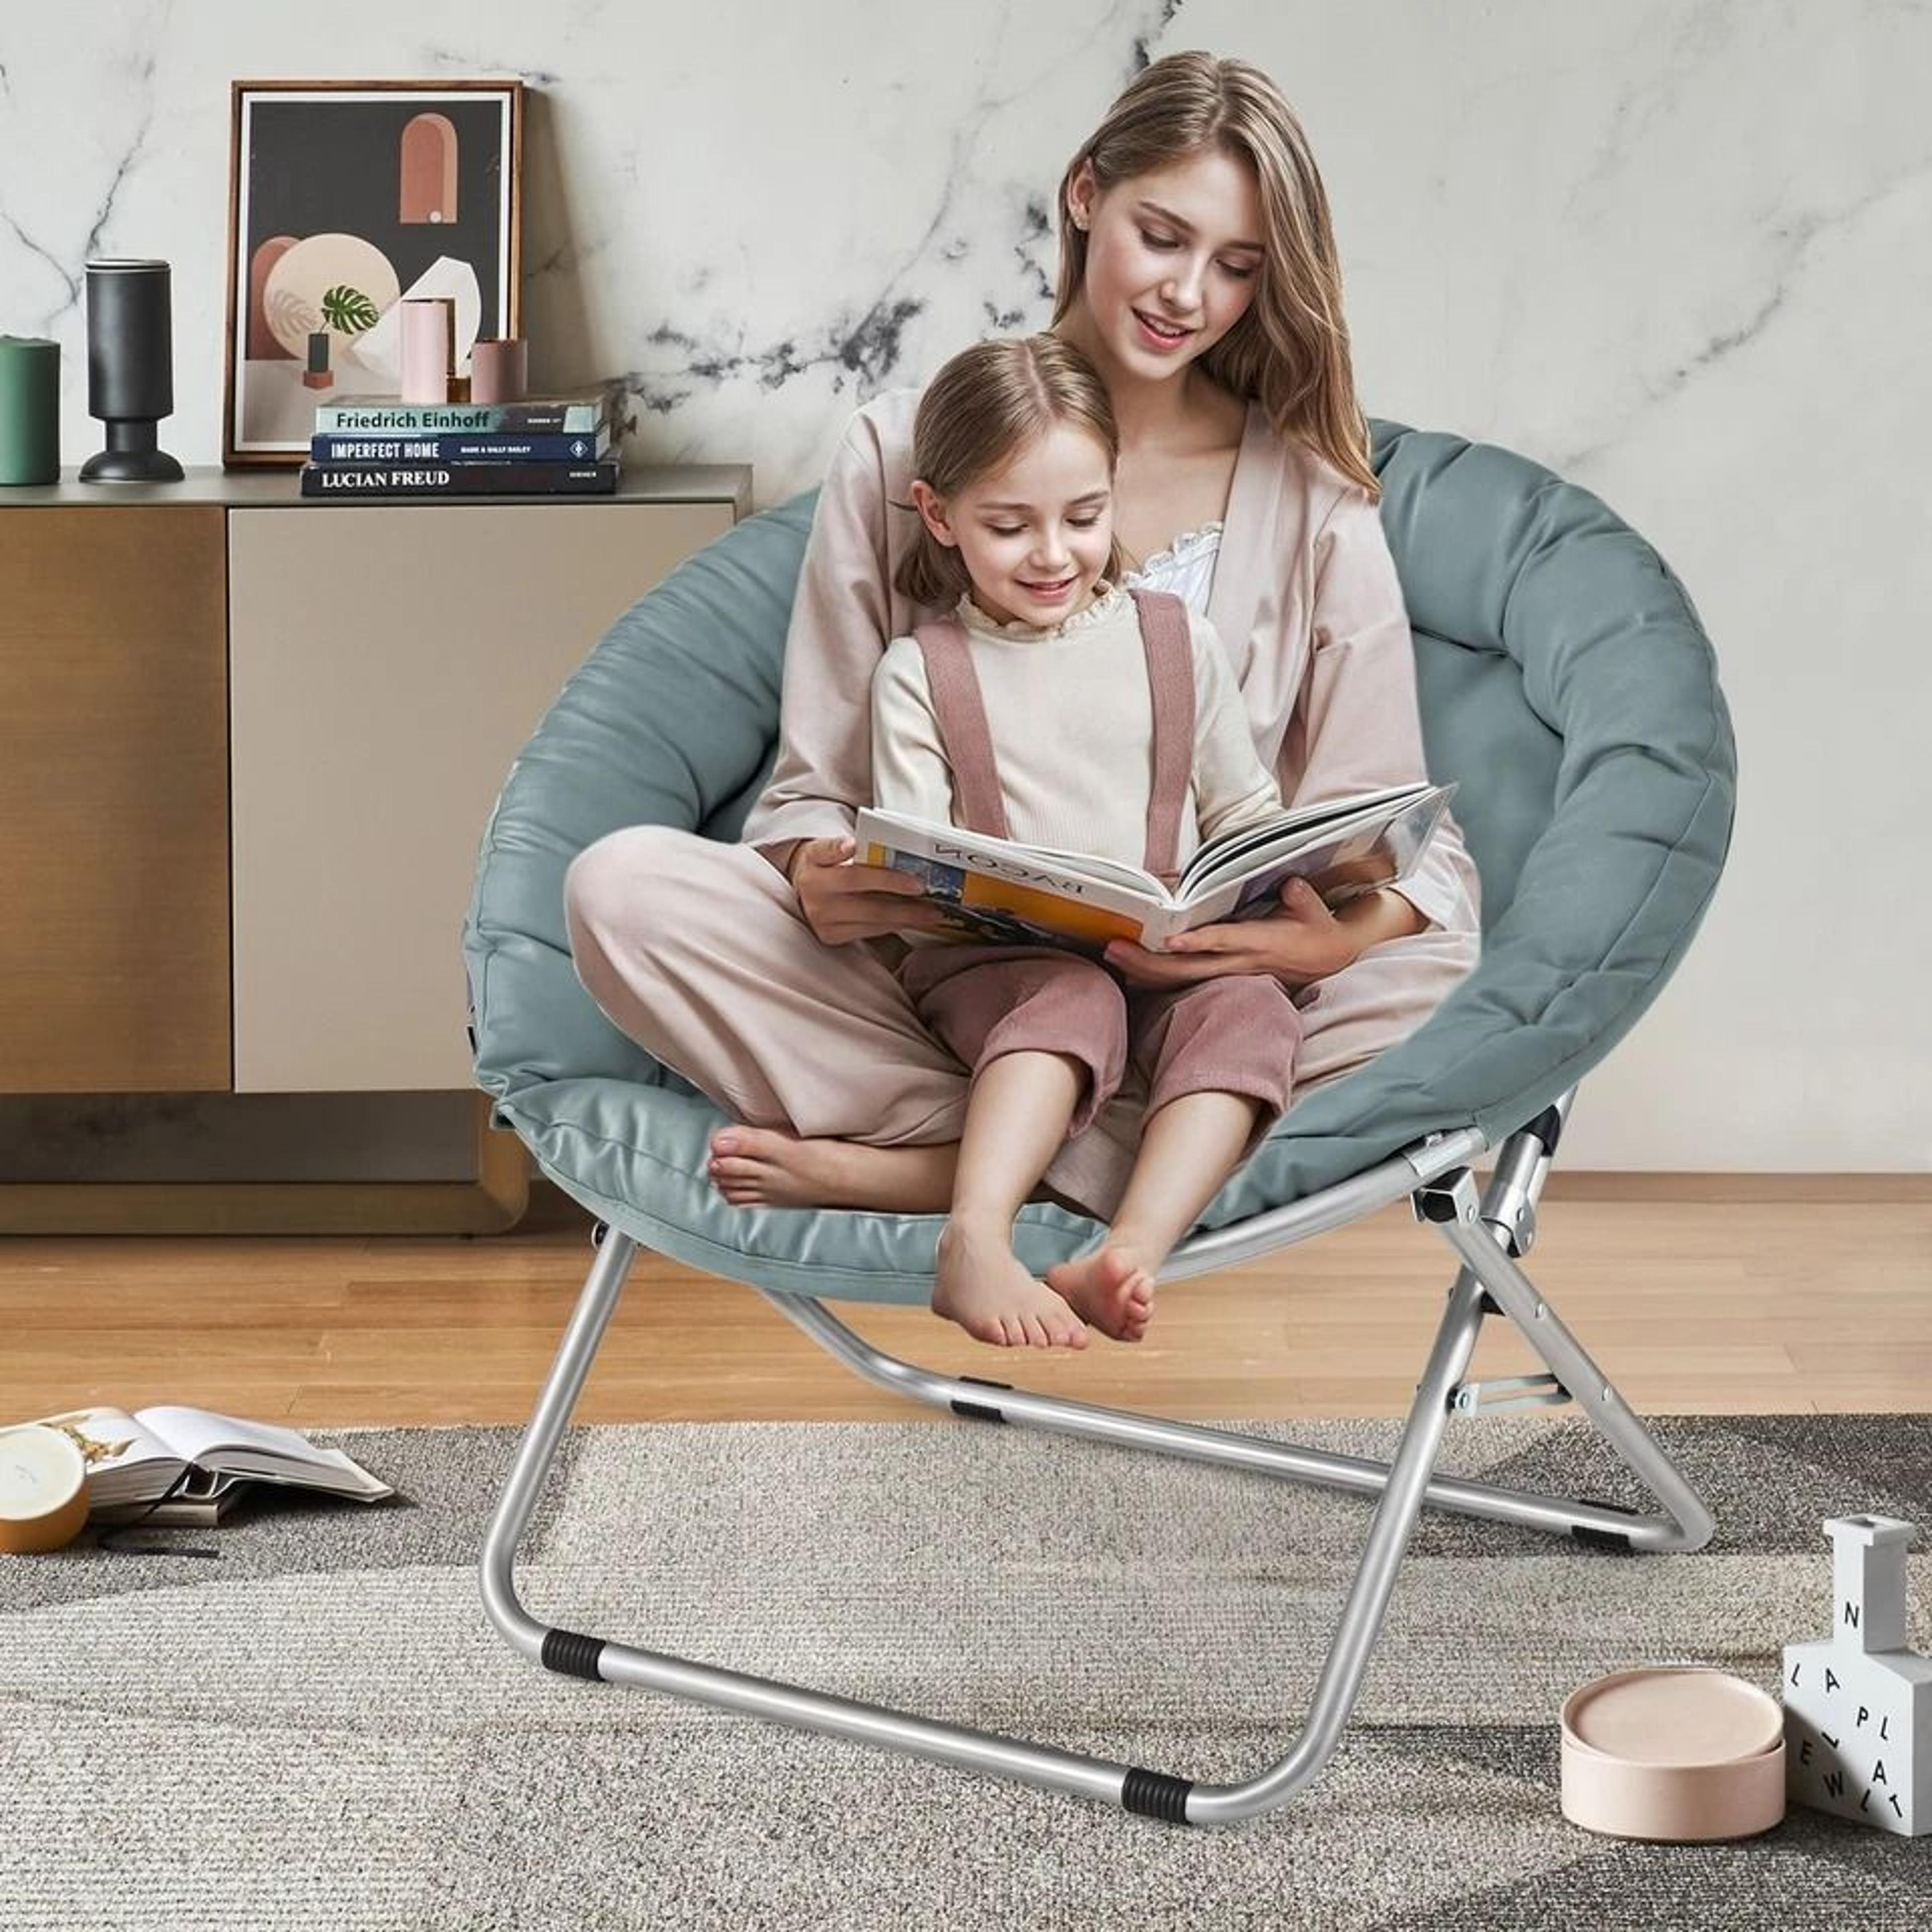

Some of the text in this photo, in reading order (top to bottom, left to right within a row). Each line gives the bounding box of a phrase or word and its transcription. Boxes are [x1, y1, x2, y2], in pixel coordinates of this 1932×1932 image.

[337, 411, 490, 428] Friedrich Einhoff
[331, 442, 440, 458] IMPERFECT HOME
[323, 470, 450, 488] LUCIAN FREUD
[1844, 1601, 1860, 1629] N
[1825, 1667, 1840, 1693] A
[1857, 1705, 1869, 1727] P
[1880, 1716, 1888, 1741] L
[1872, 1759, 1887, 1785] A
[1889, 1793, 1903, 1818] T
